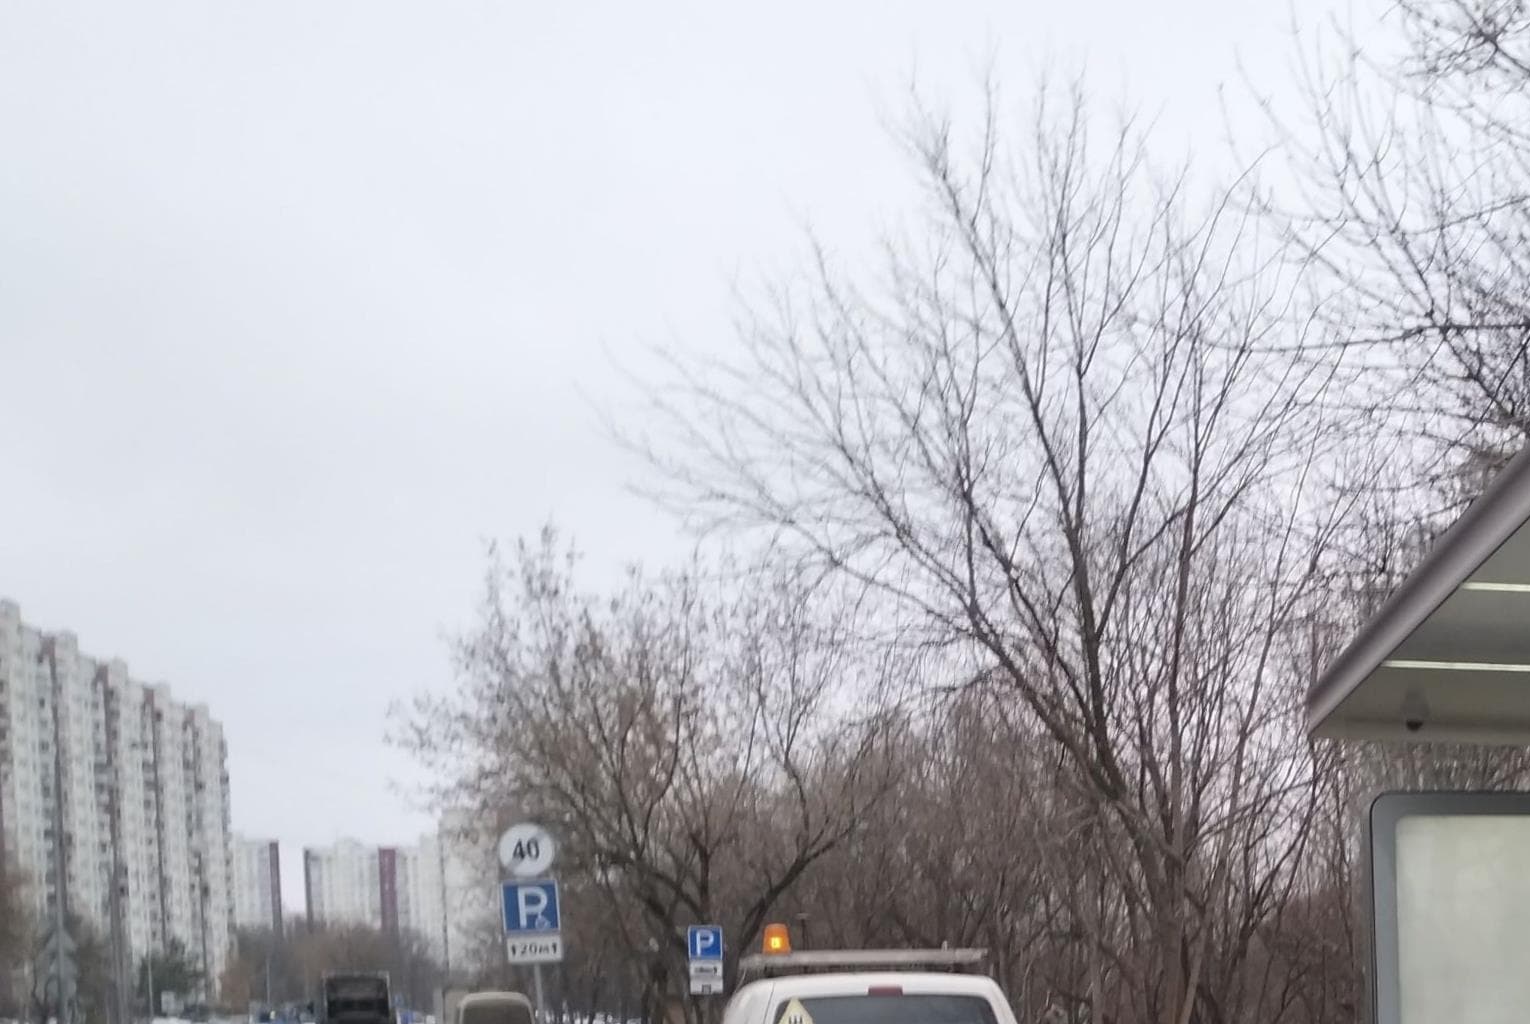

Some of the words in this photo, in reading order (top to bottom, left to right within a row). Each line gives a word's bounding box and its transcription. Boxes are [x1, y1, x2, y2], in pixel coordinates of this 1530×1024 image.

[512, 838, 540, 861] 40
[517, 885, 548, 930] P
[696, 928, 715, 957] P
